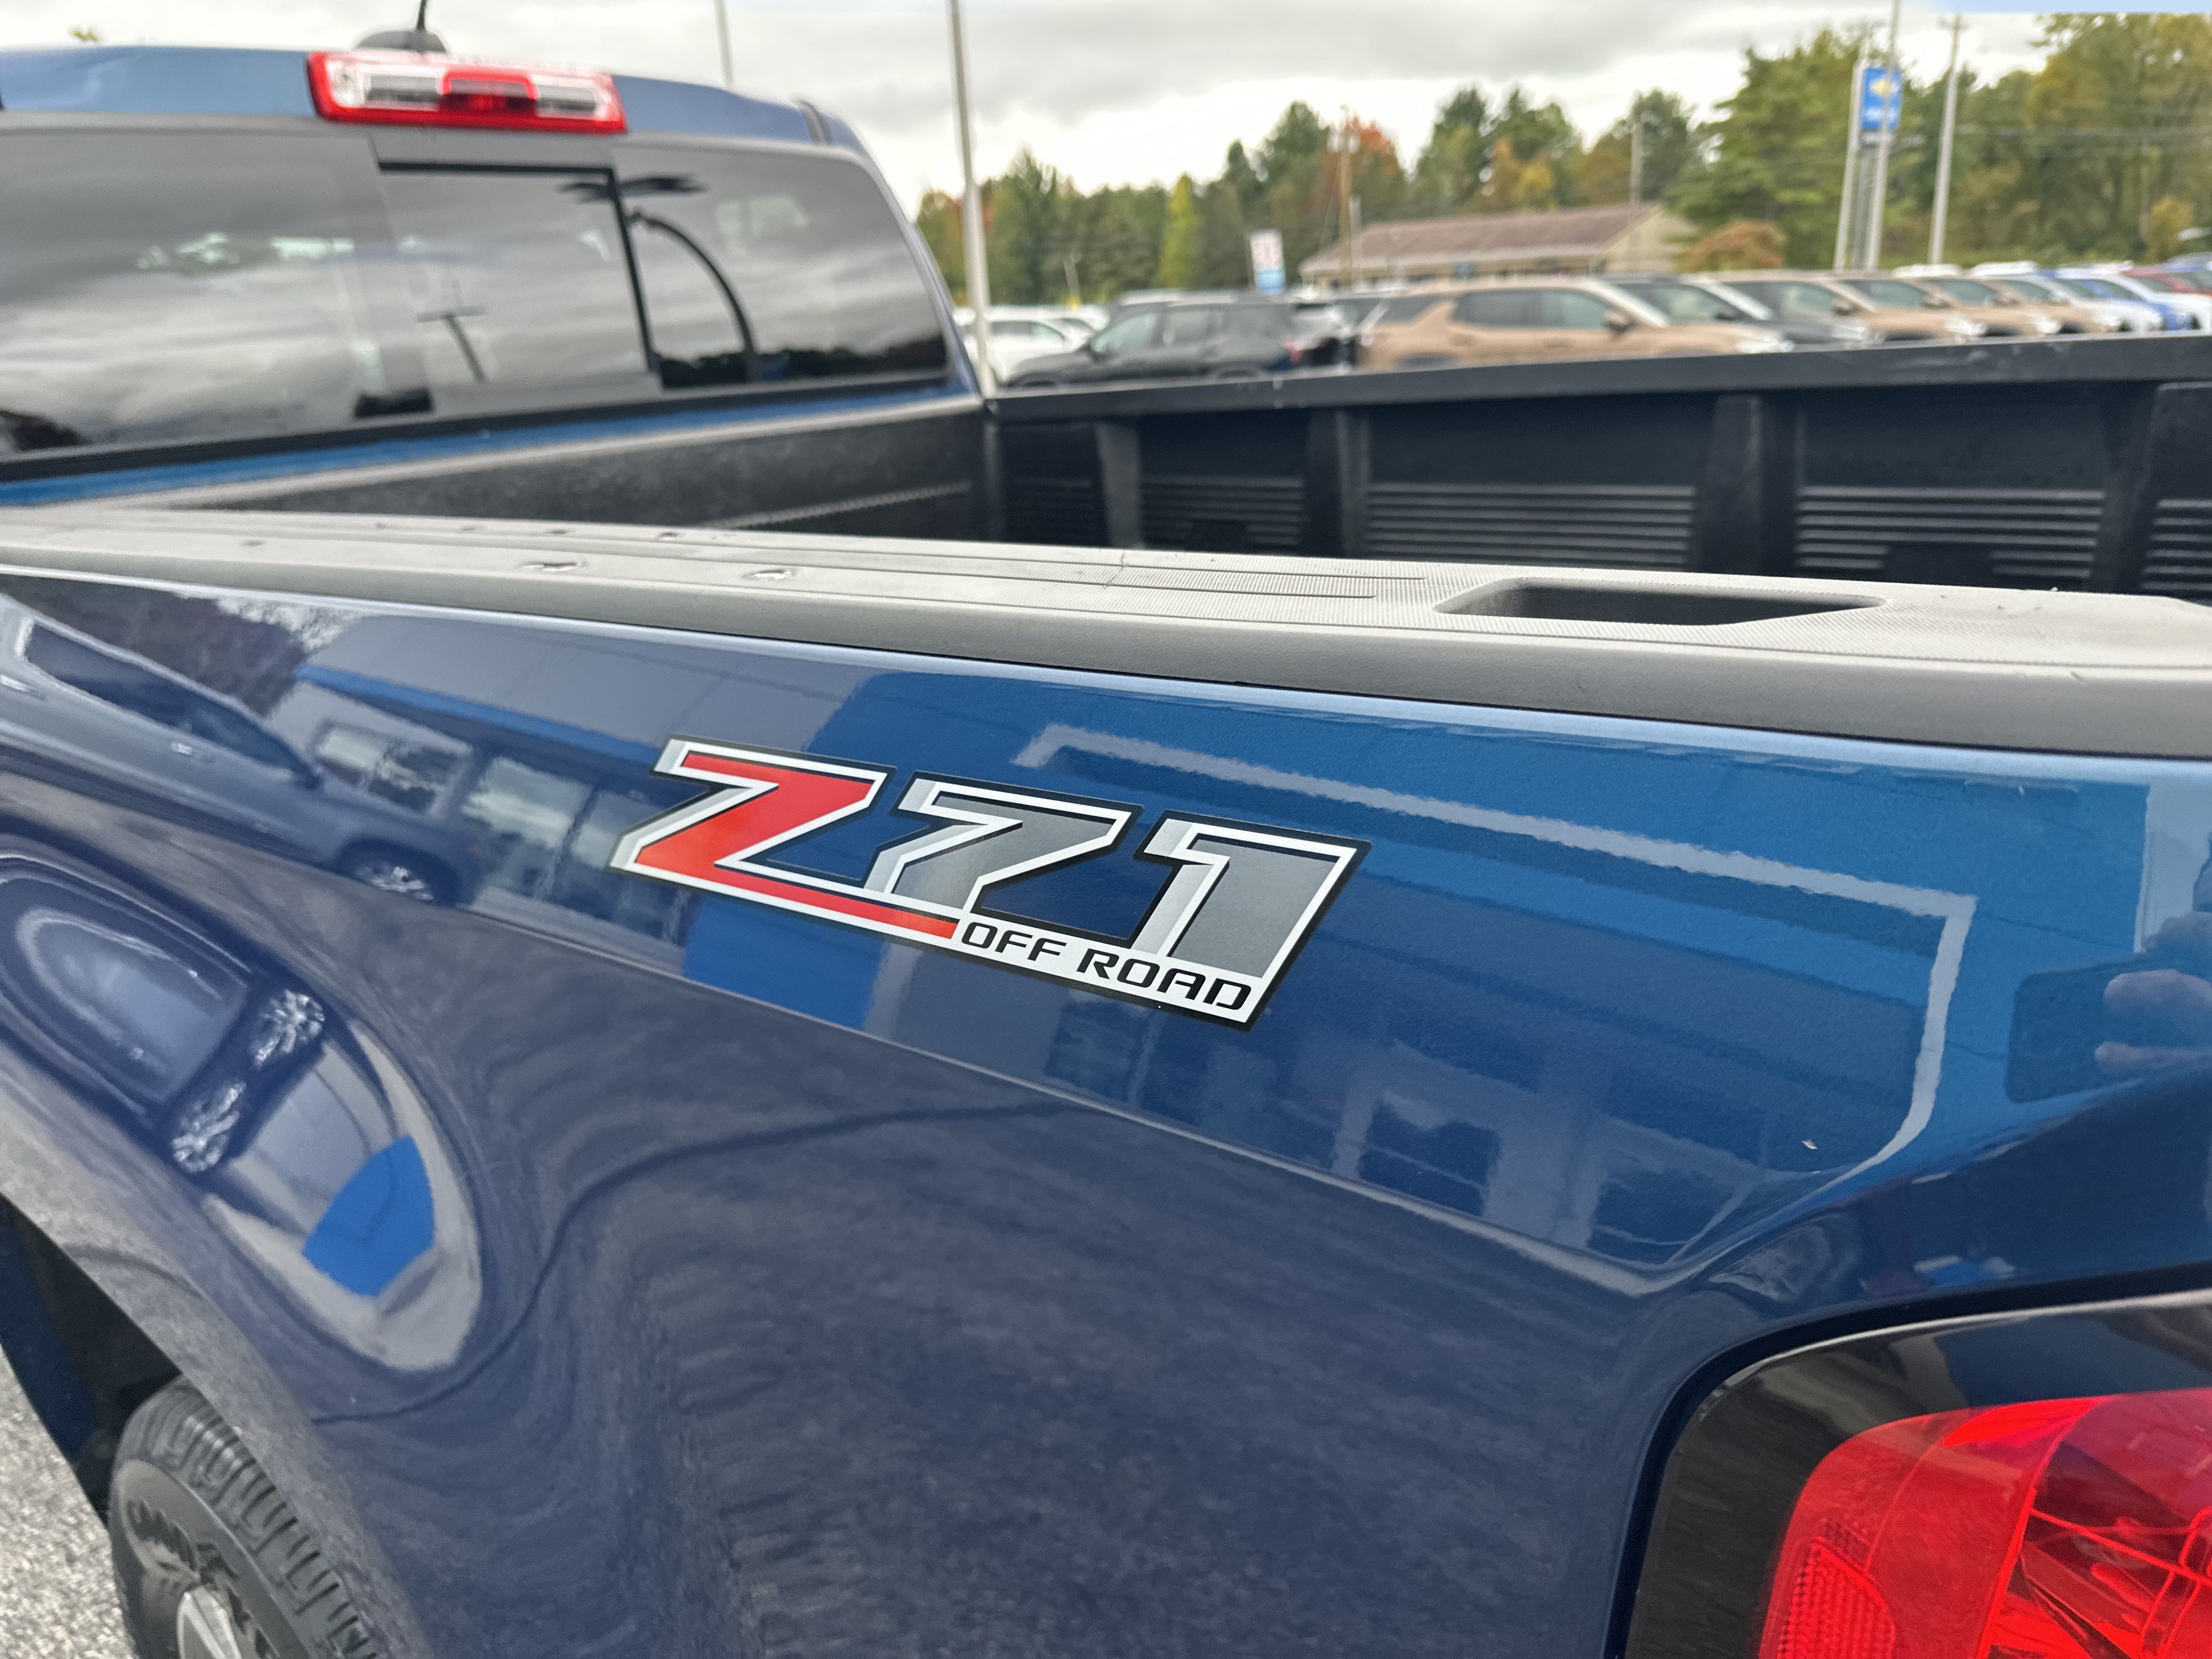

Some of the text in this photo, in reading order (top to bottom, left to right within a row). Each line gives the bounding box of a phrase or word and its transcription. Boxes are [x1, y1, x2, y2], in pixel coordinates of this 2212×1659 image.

[609, 738, 1361, 982] Z71
[961, 922, 1251, 1011] OFF ROAD
